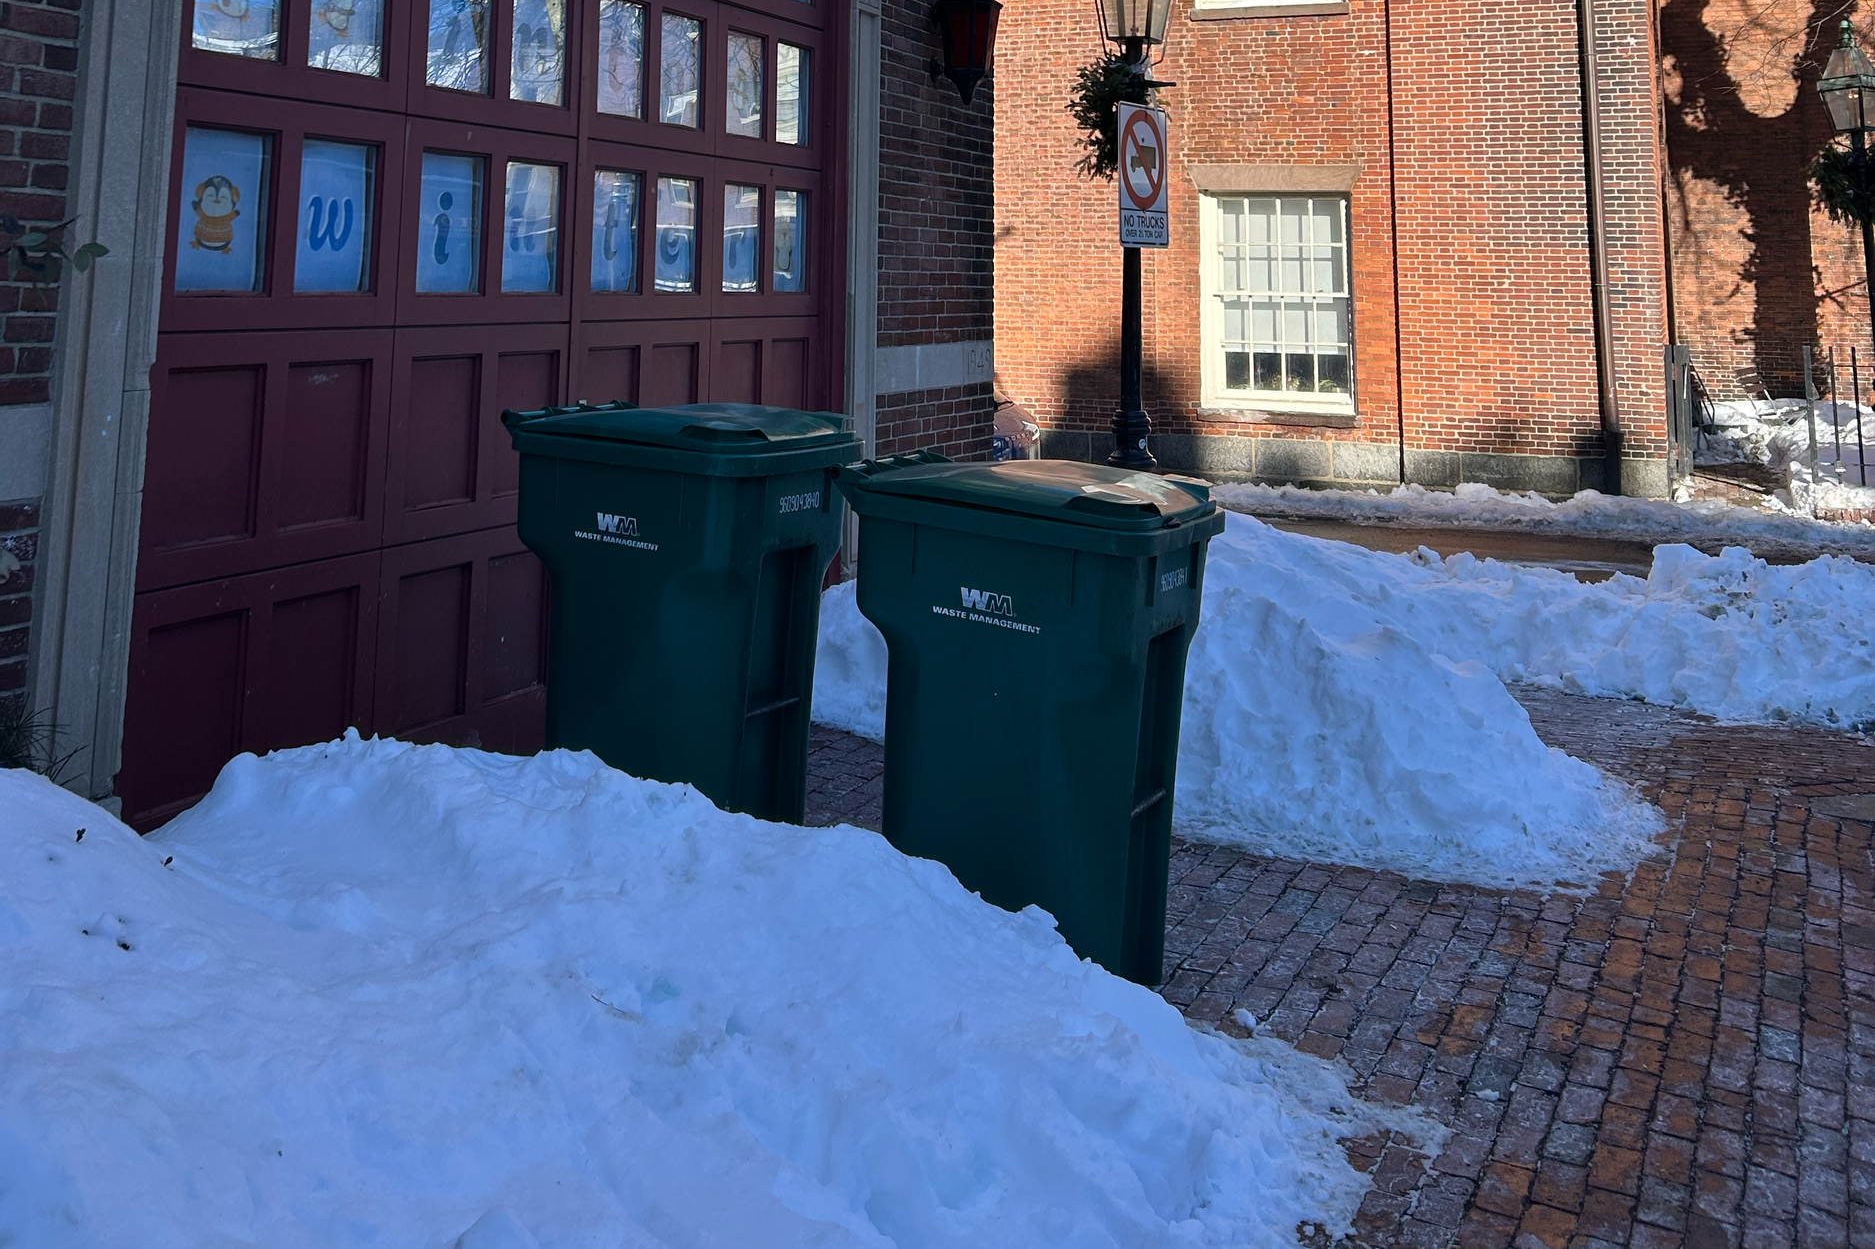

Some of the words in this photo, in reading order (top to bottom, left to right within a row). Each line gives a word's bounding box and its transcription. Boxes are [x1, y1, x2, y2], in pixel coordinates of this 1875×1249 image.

[1124, 214, 1134, 228] NO
[1137, 215, 1165, 230] TRUCKS
[1125, 230, 1138, 238] OVER
[1144, 230, 1154, 239] TON
[597, 512, 638, 537] WM
[574, 530, 602, 542] WASTE
[602, 535, 660, 551] MANAGEMENT
[960, 587, 1014, 617] WM
[932, 605, 967, 620] WASTE
[968, 613, 1042, 635] MANAGEMENT
